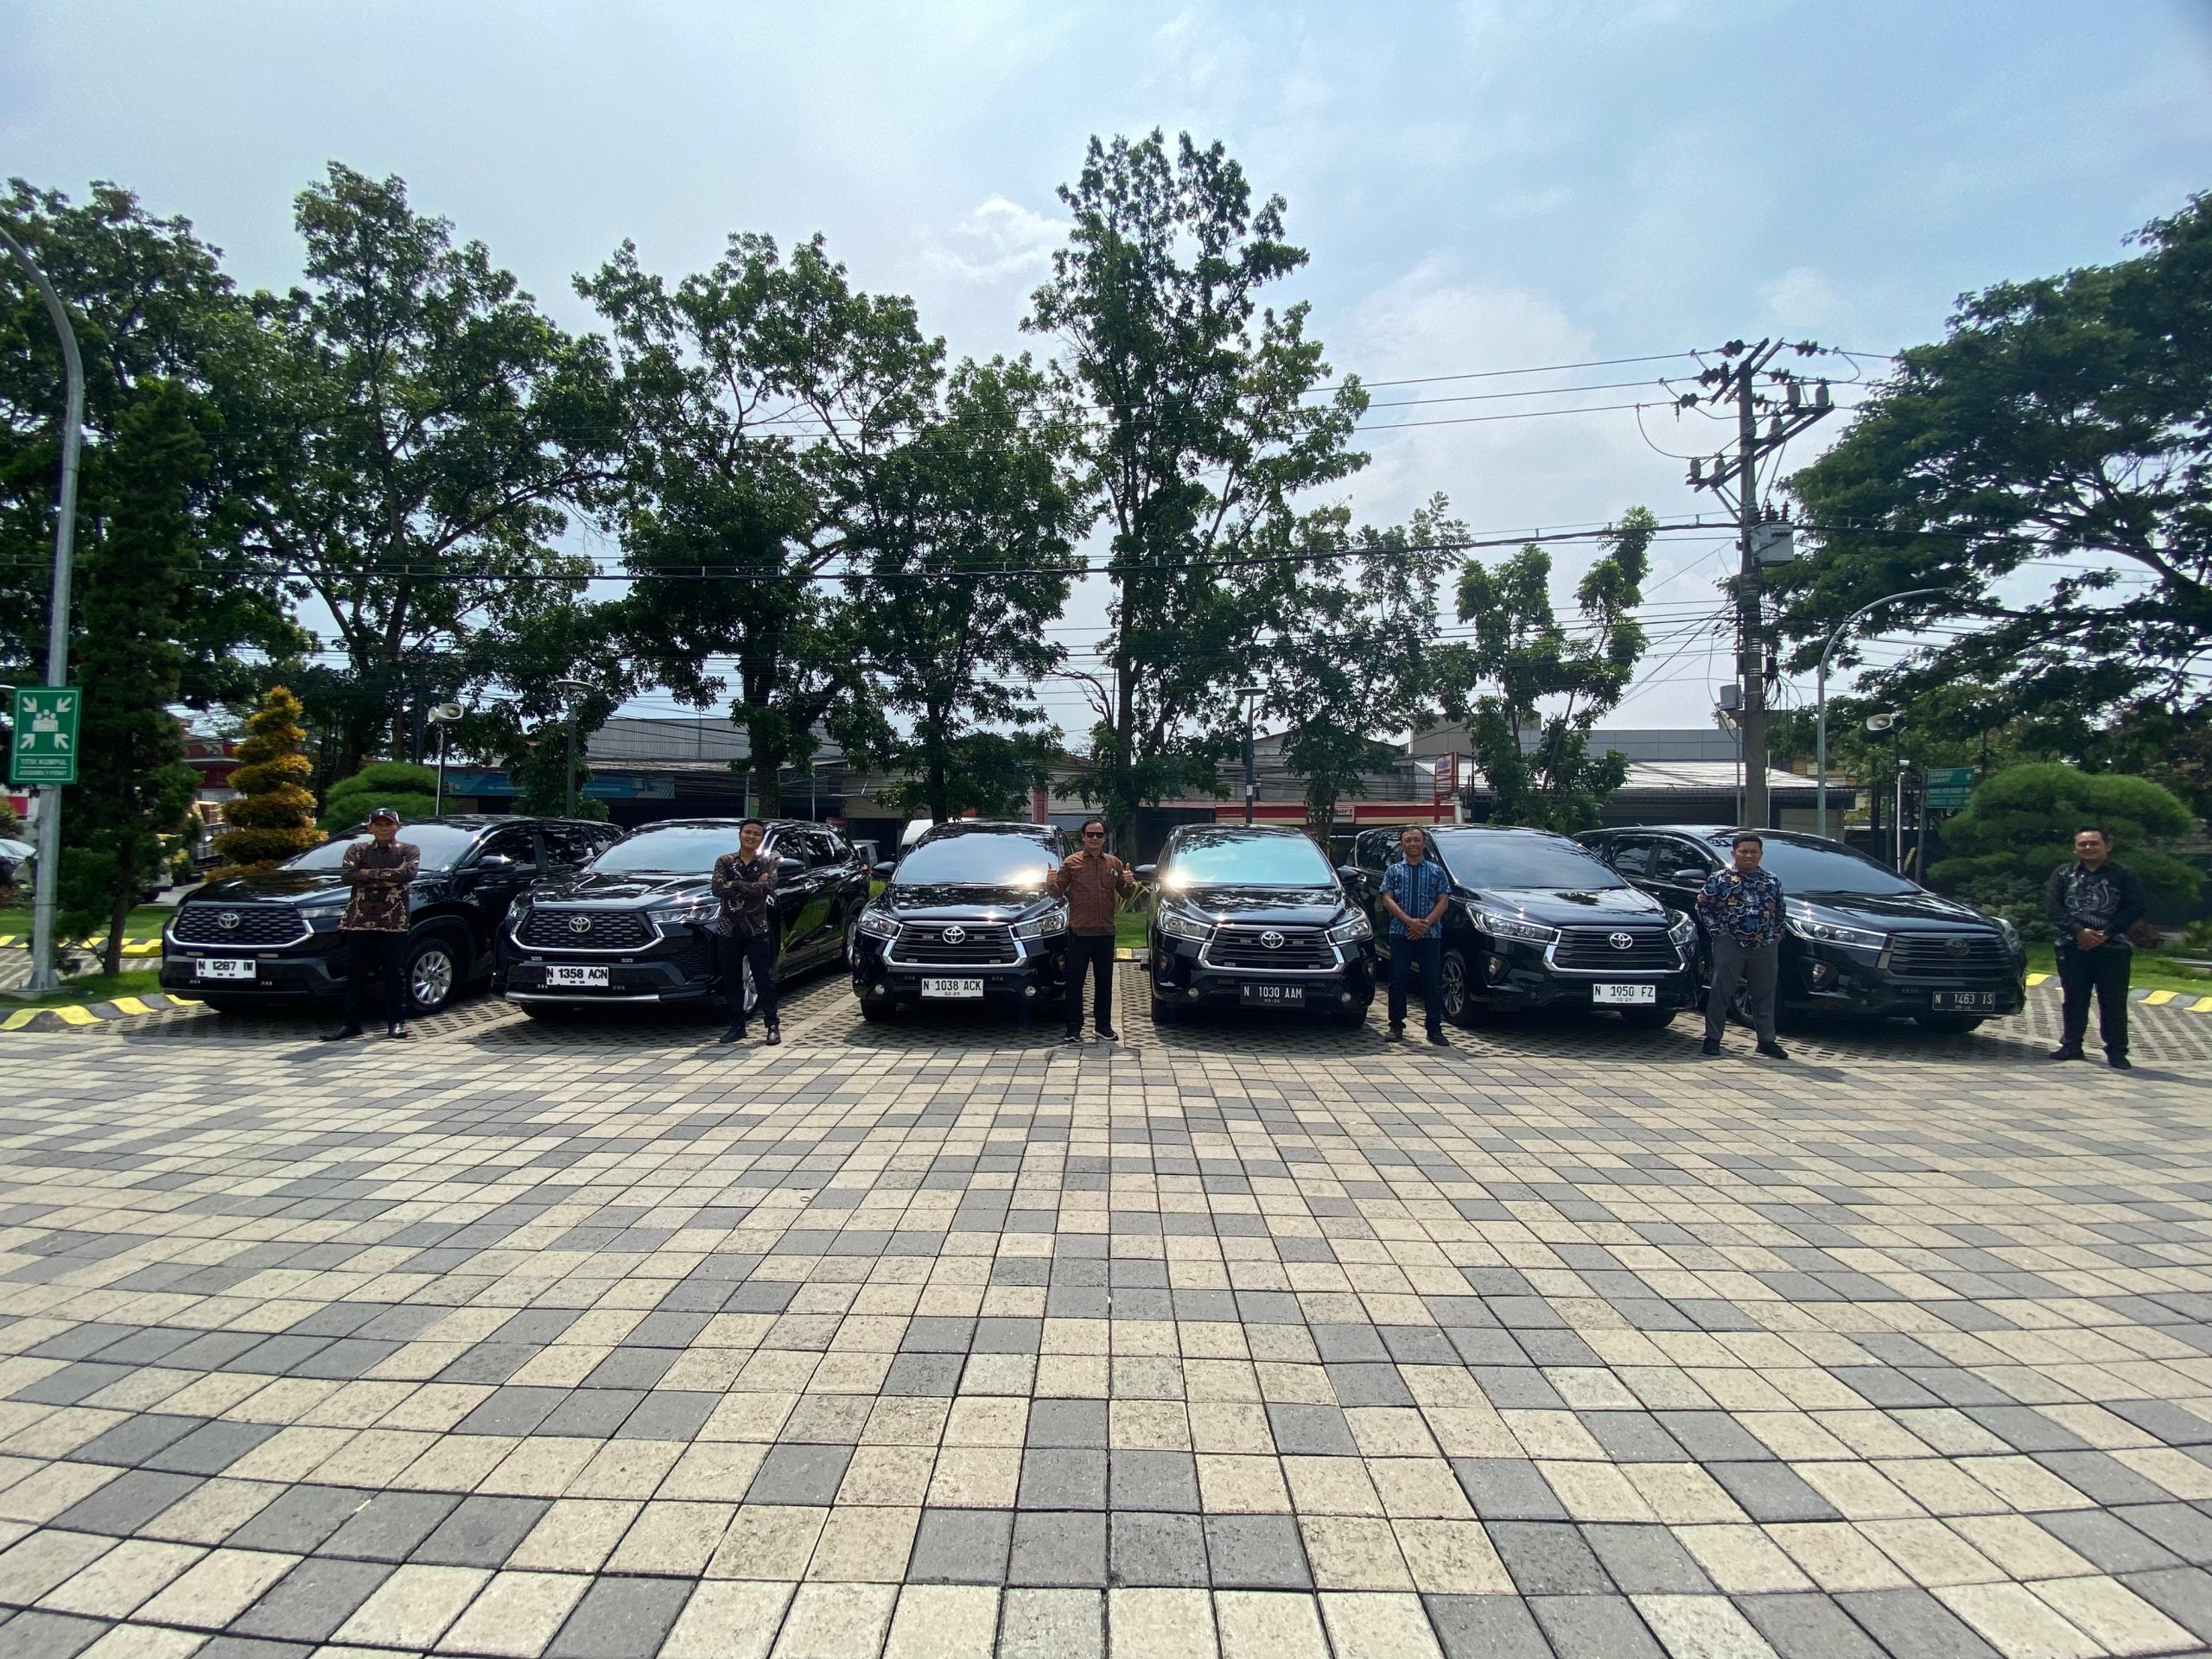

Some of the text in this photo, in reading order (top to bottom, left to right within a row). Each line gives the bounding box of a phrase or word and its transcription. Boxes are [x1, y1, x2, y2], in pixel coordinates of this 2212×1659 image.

[198, 960, 206, 970] N
[213, 961, 237, 971] 1287
[546, 968, 607, 979] N 1358 ACN
[923, 980, 982, 991] N 1038 ACK
[1594, 985, 1654, 997] N 1950 FZ
[1243, 985, 1302, 999] N 1030 AAM
[1935, 994, 1942, 1004] N
[1954, 994, 1975, 1004] 1463
